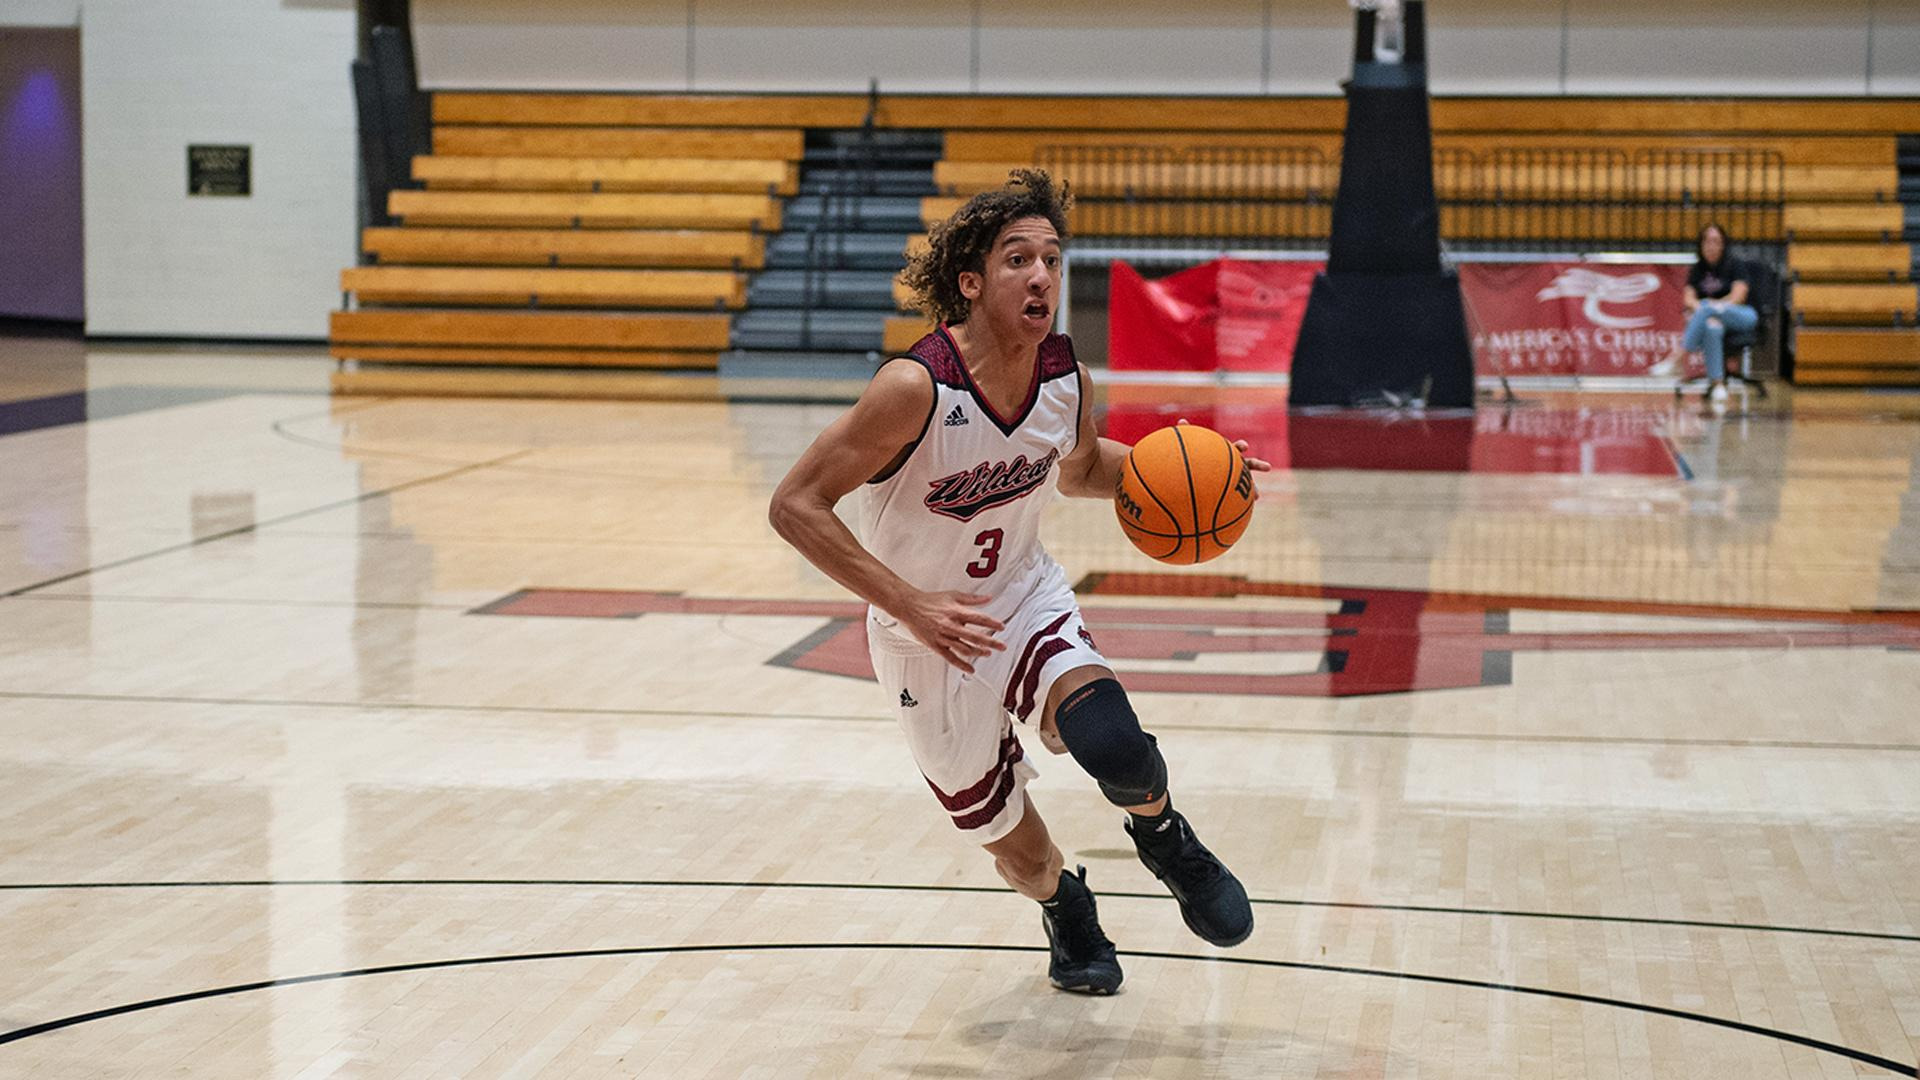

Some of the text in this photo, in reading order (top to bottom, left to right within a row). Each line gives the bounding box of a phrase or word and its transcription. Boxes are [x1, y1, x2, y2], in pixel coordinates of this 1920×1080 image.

[1592, 326, 1686, 351] CHRIST
[924, 447, 1060, 510] Wildcat
[966, 527, 1004, 578] 3
